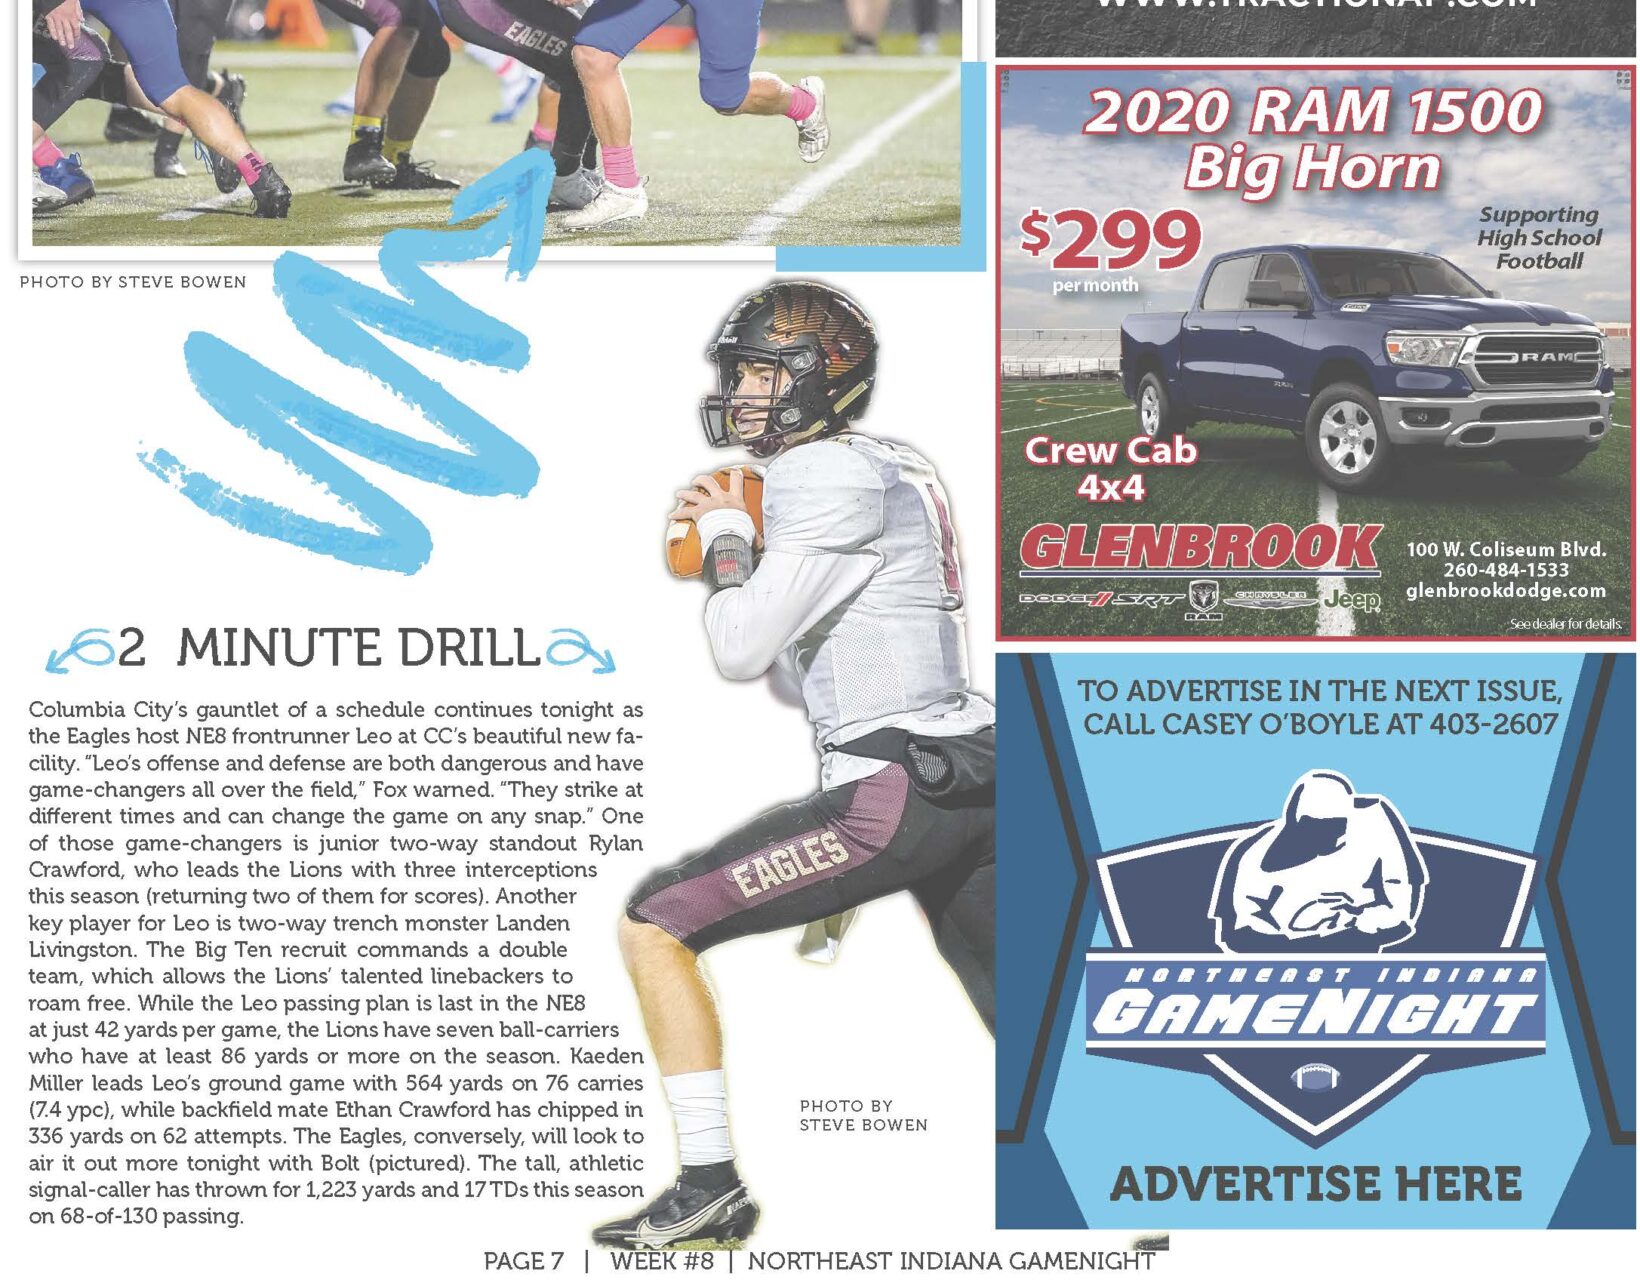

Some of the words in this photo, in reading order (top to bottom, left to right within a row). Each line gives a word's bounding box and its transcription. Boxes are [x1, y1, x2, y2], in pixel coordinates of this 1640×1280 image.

[504, 21, 567, 57] EAGLES
[1083, 87, 1230, 135] 2020
[1248, 86, 1392, 135] RAM
[1409, 87, 1545, 135] 1500
[1183, 141, 1283, 204] Big
[1293, 143, 1441, 191] Horn
[1479, 205, 1600, 228] Supporting
[1019, 206, 1203, 271] $299
[1477, 228, 1528, 251] High
[1531, 227, 1603, 246] School
[1496, 251, 1584, 270] Football
[1052, 280, 1081, 296] per
[1084, 276, 1139, 292] month
[1522, 352, 1574, 362] RAM
[1025, 436, 1118, 466] Crew
[1126, 436, 1199, 466] Cab
[1077, 473, 1146, 502] 4x4
[1019, 523, 1384, 570] GLENBROOK
[1407, 542, 1439, 557] 100
[1443, 542, 1465, 557] W.
[1469, 541, 1555, 557] Coliseum
[1560, 541, 1607, 557] Blvd.
[1443, 562, 1570, 578] 260-484-1533
[1020, 593, 1096, 604] DODGE
[1111, 593, 1187, 608] SRT
[1235, 591, 1307, 599] CHRYSLER
[1324, 589, 1379, 612] Jeep
[1406, 581, 1607, 602] glenbrookdodge.com
[1185, 612, 1223, 622] RAM
[1510, 618, 1531, 630] See
[1533, 618, 1566, 630] dealer
[1568, 618, 1584, 630] for
[1585, 618, 1623, 630] details.
[119, 627, 146, 667] 2
[176, 627, 382, 667] MINUTE
[397, 627, 541, 667] DRILL
[1078, 679, 1118, 702] TO
[1126, 679, 1283, 702] ADVERTISE
[1289, 679, 1322, 702] IN
[1328, 679, 1388, 702] THE
[1394, 679, 1471, 702] NEXT
[1476, 679, 1563, 706] ISSUE,
[28, 700, 126, 718] Columbia
[196, 700, 280, 723] gauntlet
[287, 700, 308, 718] of
[315, 705, 328, 718] a
[335, 700, 425, 718] schedule
[434, 700, 533, 718] continues
[540, 700, 615, 723] tonight
[623, 705, 644, 718] as
[1083, 712, 1156, 735] CALL
[1162, 712, 1253, 735] CASEY
[1385, 712, 1424, 735] AT
[1429, 712, 1560, 735] 403-2607
[732, 830, 849, 898] EAGLES
[1125, 968, 1350, 982] NORTHEAST
[1377, 968, 1537, 982] INDIANA
[1110, 1165, 1382, 1202] ADVERTISE
[1394, 1165, 1523, 1202] HERE
[484, 1251, 545, 1271] PAGE
[551, 1251, 565, 1271] 7
[610, 1251, 677, 1271] WEEK
[683, 1251, 714, 1271] #8
[748, 1251, 893, 1271] NORTHEAST
[901, 1251, 1003, 1271] INDIANA
[1009, 1251, 1157, 1271] GAMENIGHT
